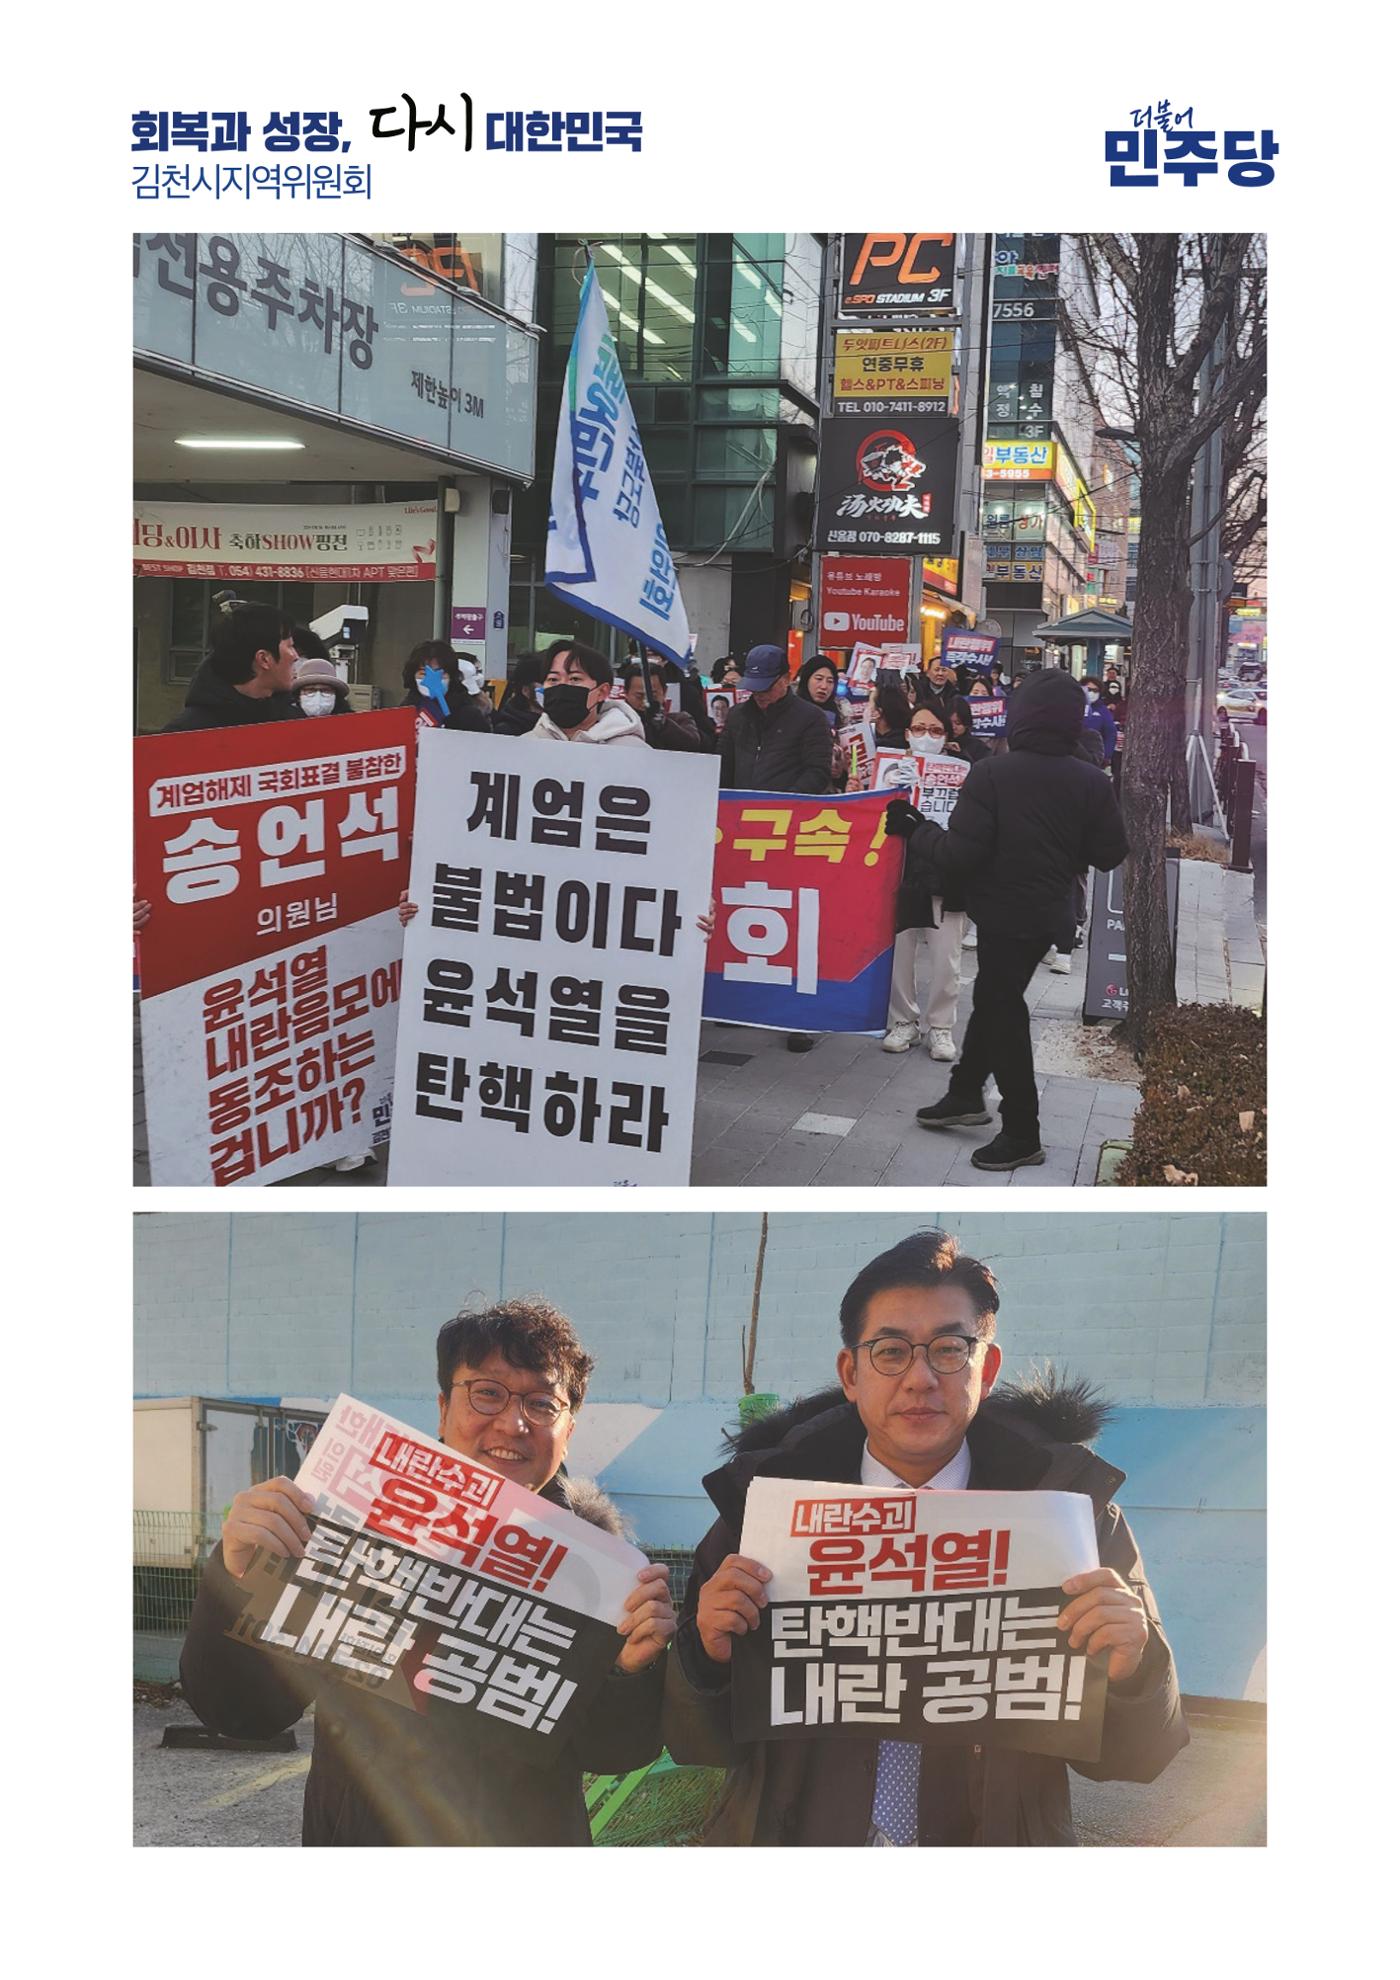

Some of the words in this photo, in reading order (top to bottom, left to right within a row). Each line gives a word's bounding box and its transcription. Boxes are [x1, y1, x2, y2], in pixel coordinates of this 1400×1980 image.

[849, 233, 953, 285] PC
[133, 233, 378, 370] 전용주차장
[876, 293, 925, 303] STADIUM
[927, 289, 951, 302] 3F
[411, 370, 461, 413] 제한높이
[464, 393, 484, 418] 3M
[840, 378, 944, 391] 헬스&PT&스피닝
[862, 357, 924, 372] 연중무휴
[838, 402, 861, 412] TEL
[863, 402, 945, 412] 010-7411-8912
[859, 532, 941, 544] 070-8287-1115
[827, 572, 853, 581] 유튜브
[855, 572, 882, 582] 노래방
[827, 587, 863, 596] Youtube
[864, 588, 900, 597] Karaoke
[852, 614, 905, 631] YouTube
[156, 771, 252, 810] 계엄해제
[257, 761, 341, 795] 국회표결
[345, 751, 403, 782] 불참한
[466, 770, 651, 856] 계엄은
[162, 785, 400, 905] 송언석
[256, 892, 338, 937] 의원님
[430, 862, 683, 957] 불법이다
[720, 880, 820, 995] 회
[1107, 918, 1125, 931] PA
[201, 945, 328, 1034] 윤석열
[205, 958, 403, 1081] 내란음모에
[423, 957, 671, 1057] 윤석열을
[208, 1029, 376, 1135] 동조하는
[415, 1052, 670, 1154] 탄핵하라
[209, 1077, 366, 1187] 겁니까?
[376, 1434, 500, 1508] 내란수괴
[364, 1475, 569, 1594] 윤석열!
[795, 1500, 912, 1534] 내란수괴
[294, 1516, 577, 1668] 탄핵반대는
[807, 1529, 1011, 1596] 윤석열!
[260, 1583, 417, 1680] 내란
[412, 1632, 579, 1735] 공범!
[771, 1596, 1060, 1659] 탄핵반대는
[770, 1662, 907, 1726] 내란
[922, 1654, 1086, 1725] 공범!
